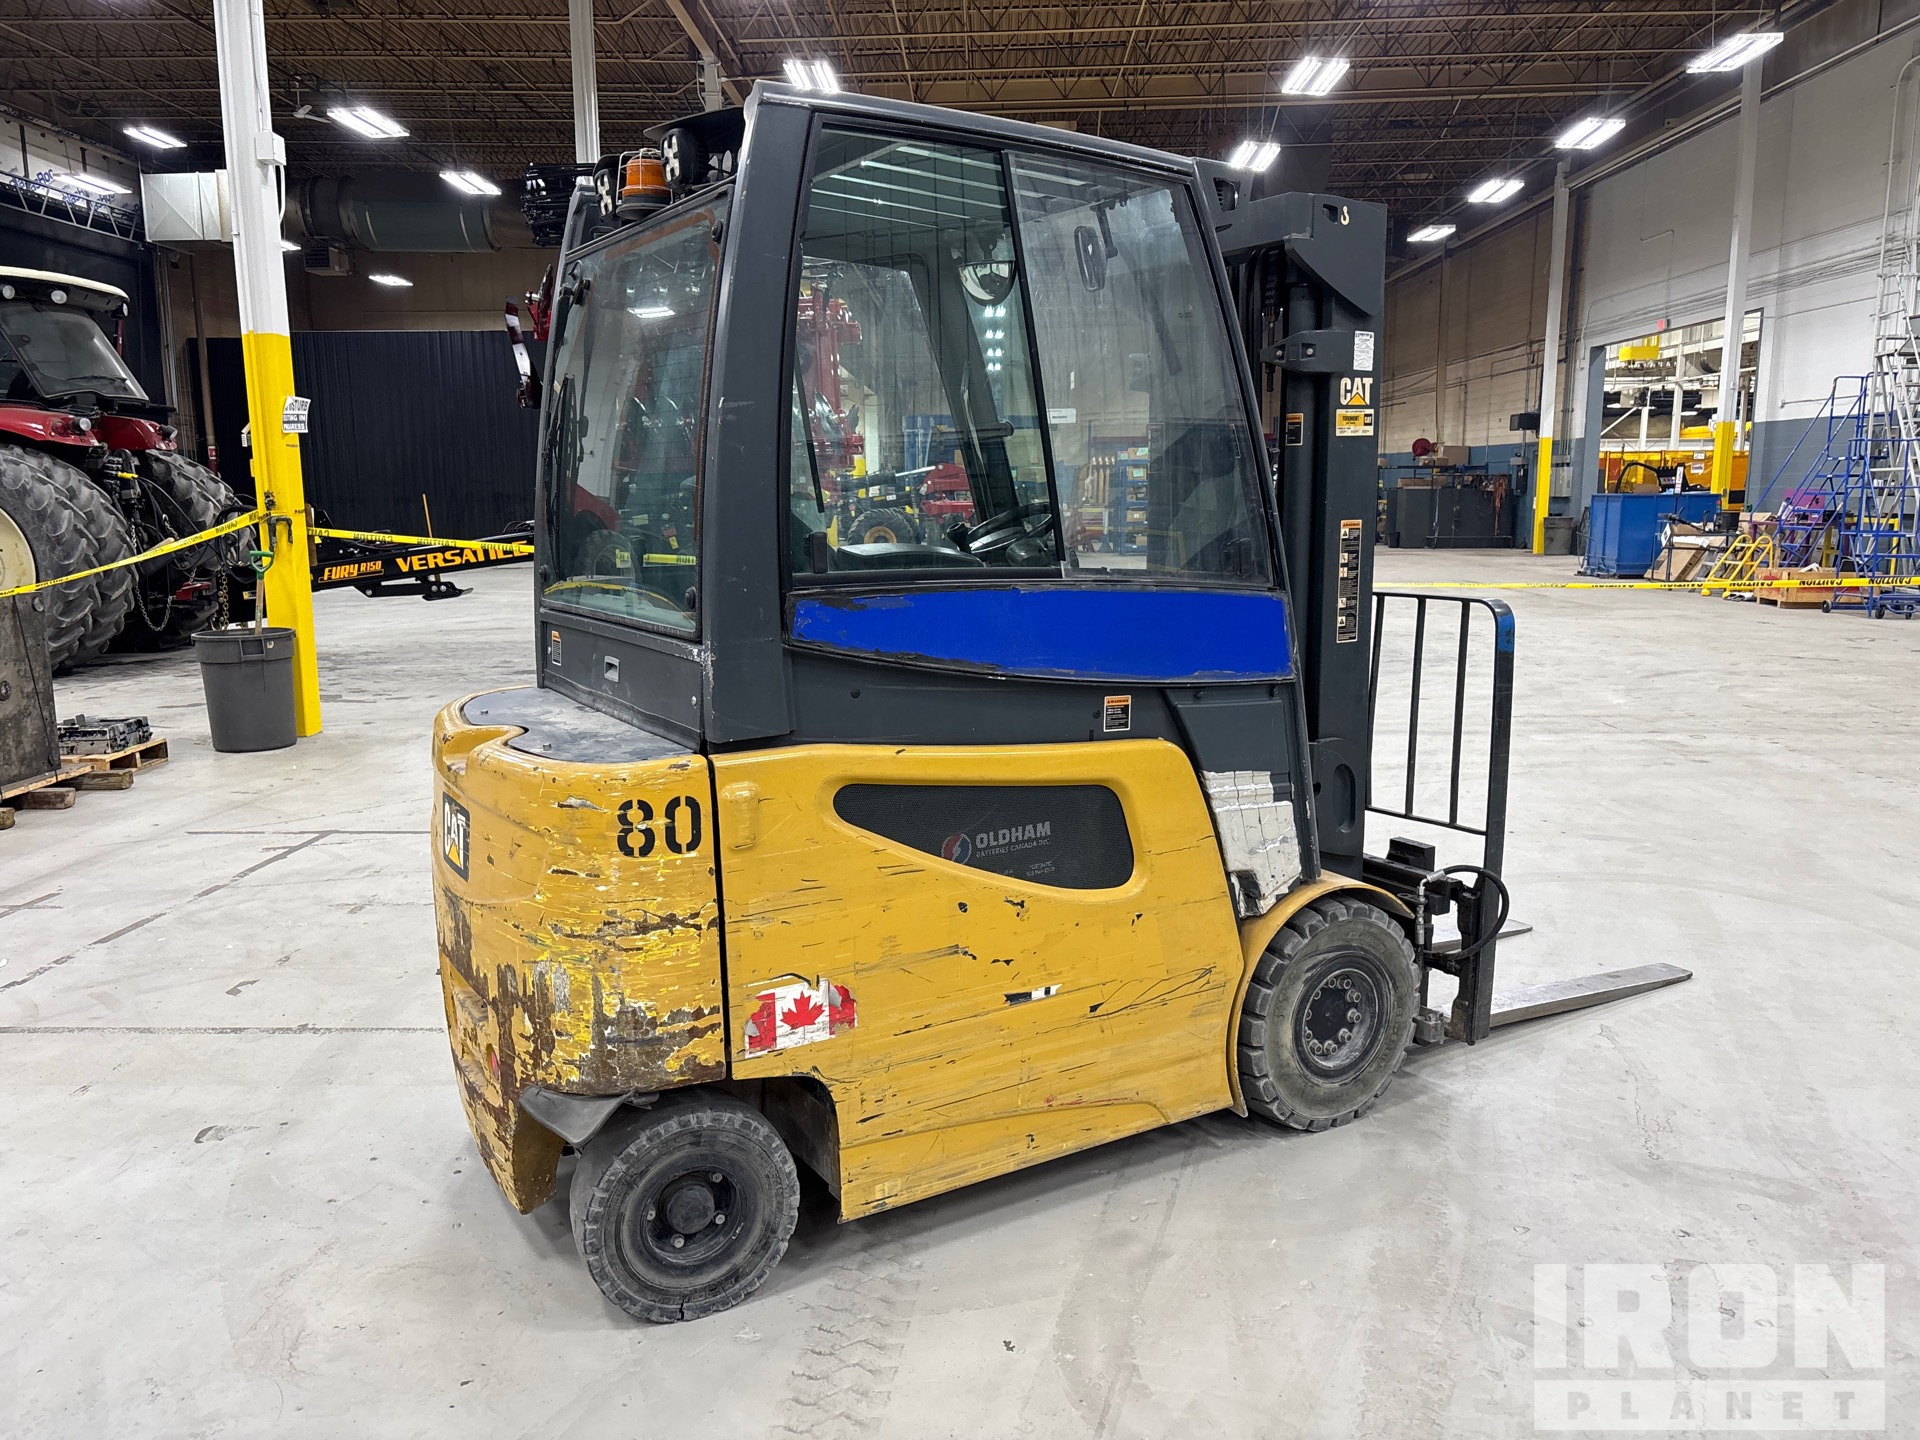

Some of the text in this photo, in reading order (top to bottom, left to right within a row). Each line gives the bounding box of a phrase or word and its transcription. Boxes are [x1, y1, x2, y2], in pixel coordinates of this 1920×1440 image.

[1340, 377, 1373, 406] CAT
[323, 561, 382, 580] FURY R150
[444, 801, 468, 870] CAT
[617, 795, 701, 858] 80
[975, 821, 1051, 849] OLDHAM
[976, 845, 1009, 858] BATTERIES
[1010, 840, 1038, 851] CANADA
